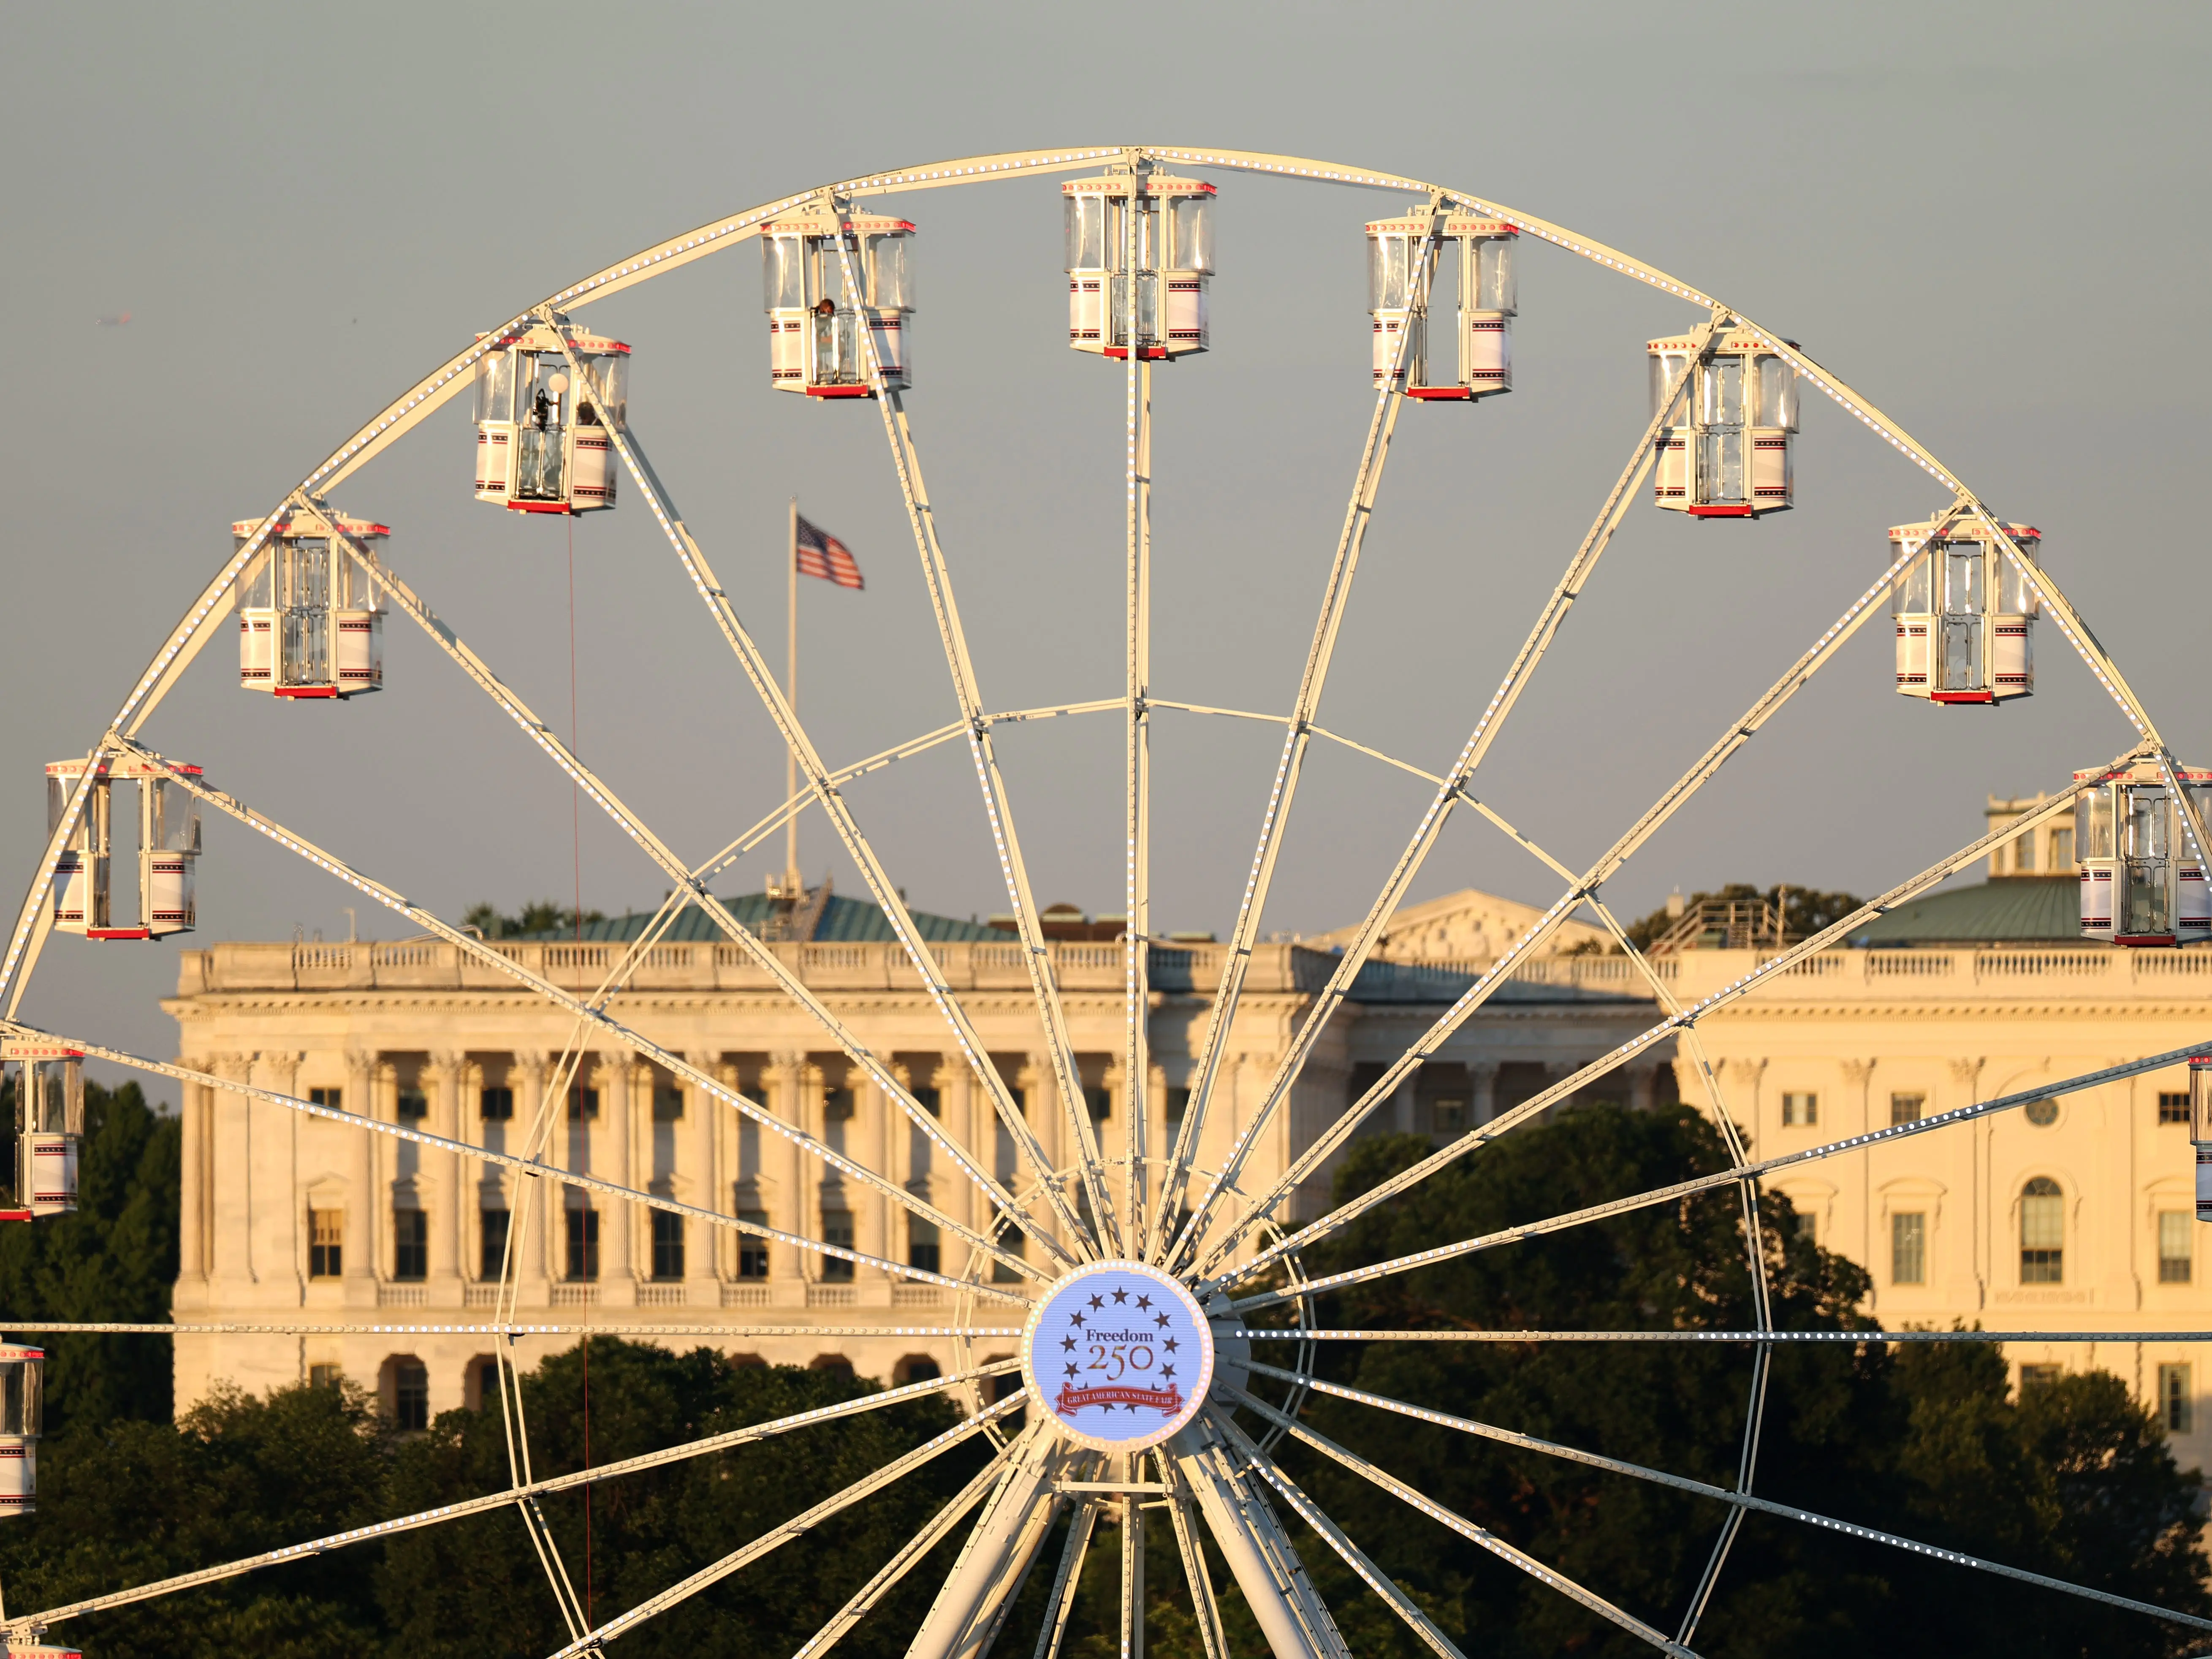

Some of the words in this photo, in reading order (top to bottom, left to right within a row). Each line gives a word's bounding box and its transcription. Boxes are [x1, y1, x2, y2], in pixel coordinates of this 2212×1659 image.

[1086, 1328, 1153, 1342] Freedom
[1087, 1344, 1153, 1381] 250
[1067, 1393, 1090, 1404] GREAT
[1092, 1391, 1131, 1400] AMERICAN
[1132, 1393, 1155, 1402] STATE
[1155, 1396, 1172, 1404] FAIR
